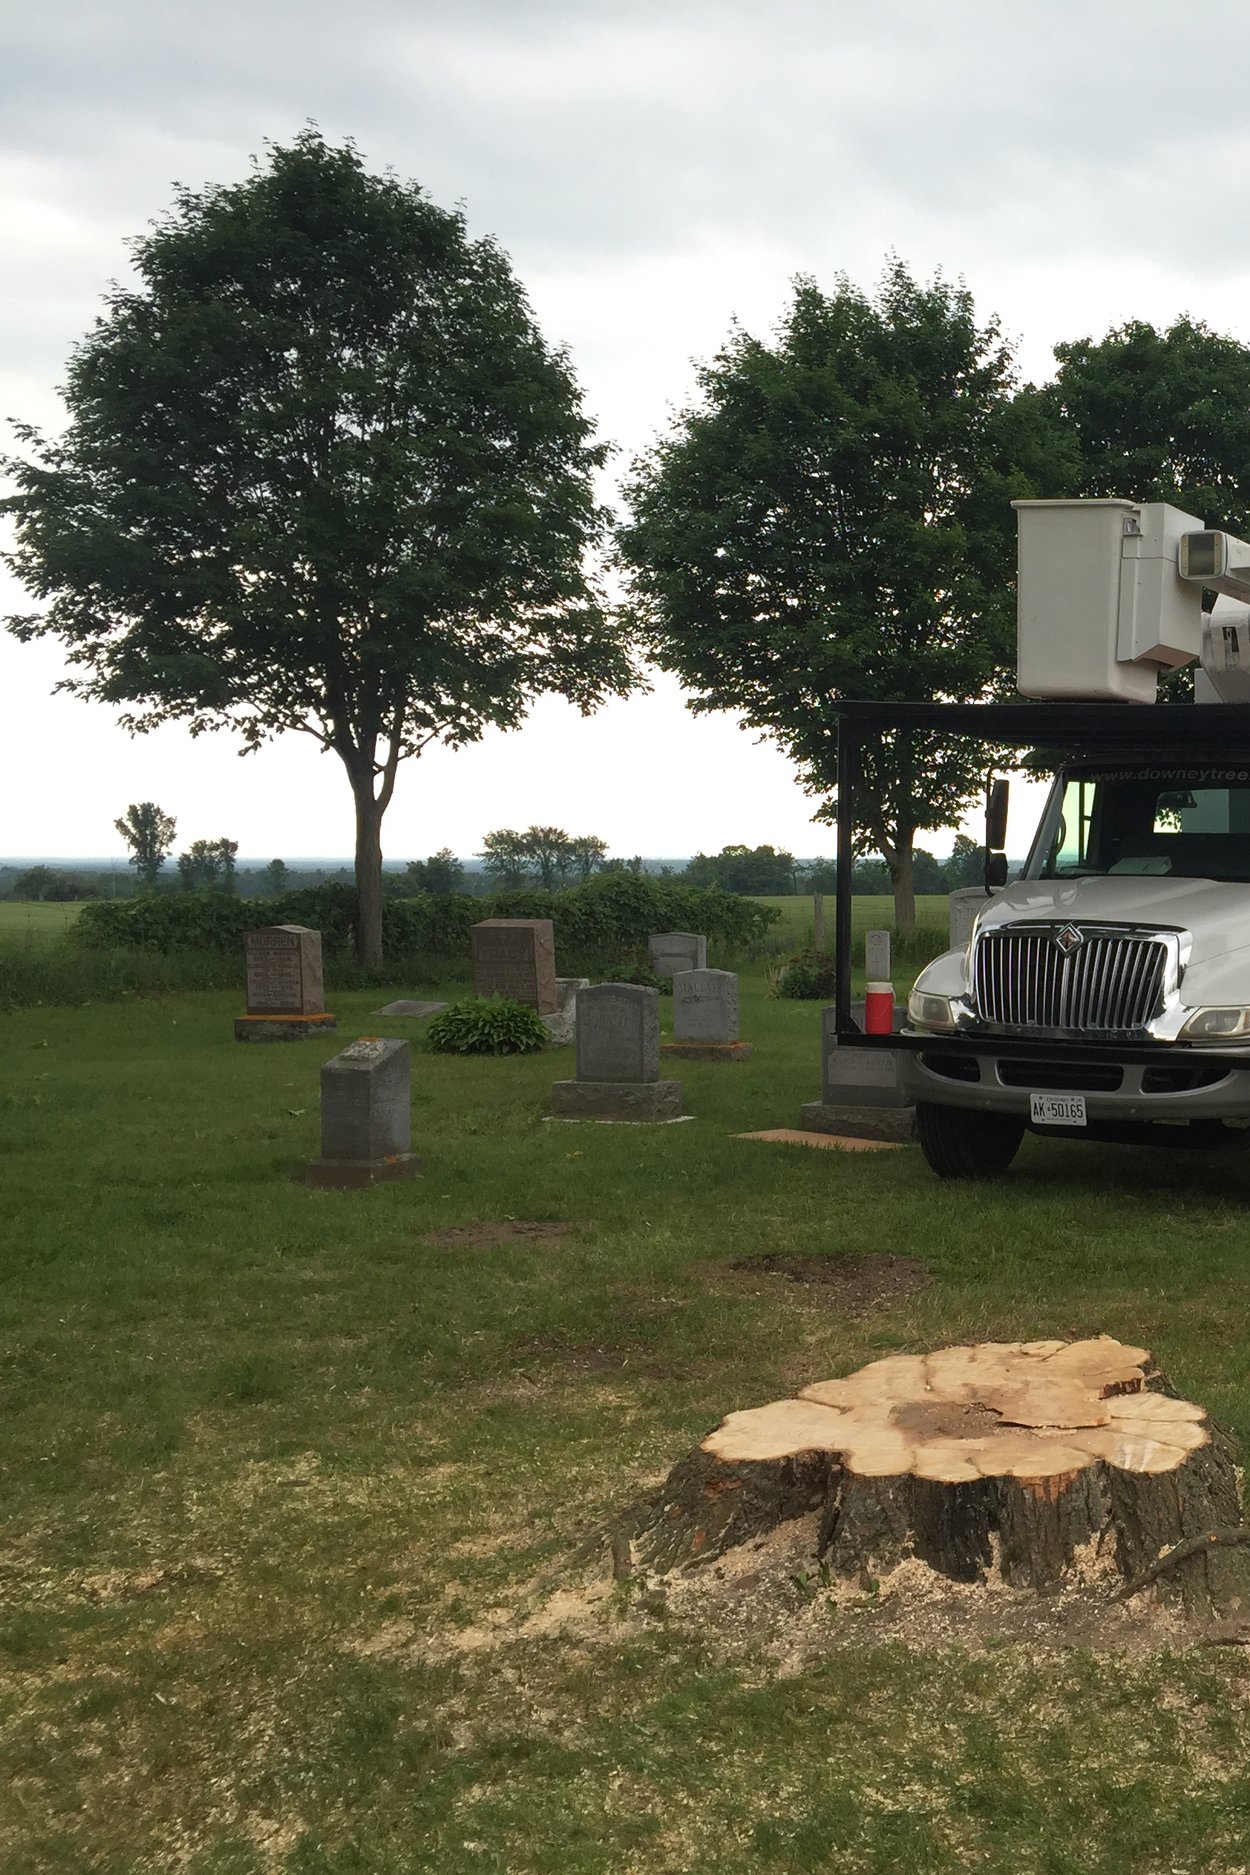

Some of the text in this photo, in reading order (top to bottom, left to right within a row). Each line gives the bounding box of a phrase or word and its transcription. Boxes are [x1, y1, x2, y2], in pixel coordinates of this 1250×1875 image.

[250, 935, 296, 947] MORREN
[1034, 1102, 1083, 1118] AK 50165
